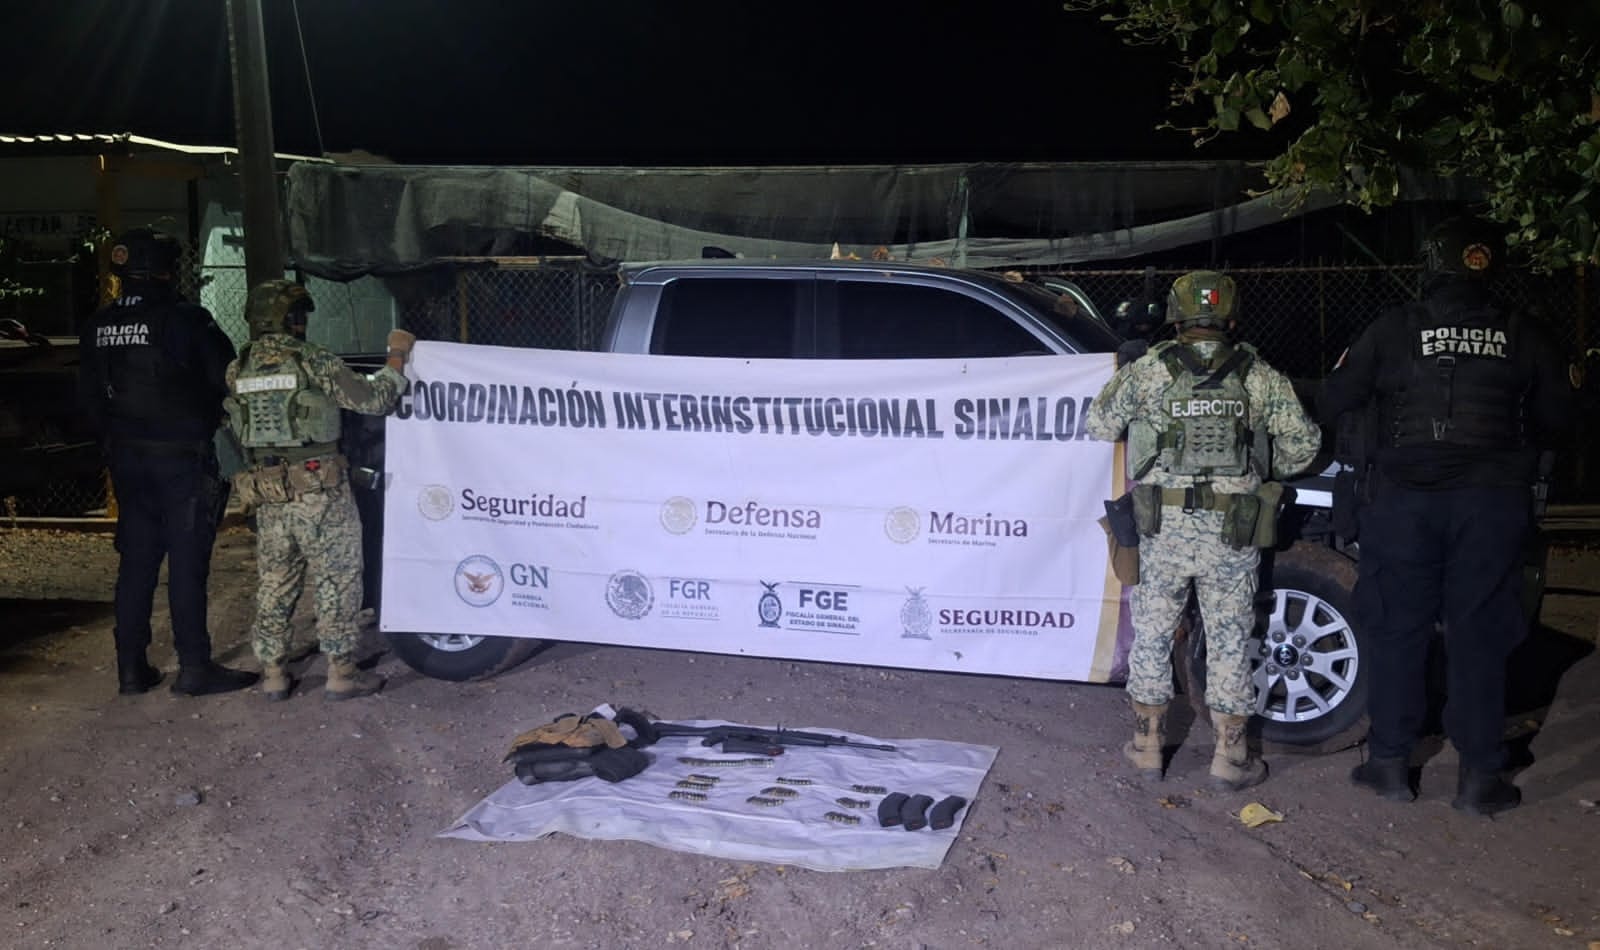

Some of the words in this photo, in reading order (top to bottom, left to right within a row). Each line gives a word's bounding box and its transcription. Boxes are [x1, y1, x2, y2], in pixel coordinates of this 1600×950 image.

[97, 322, 150, 337] POLICÍA
[1421, 327, 1507, 344] POLICÍA
[96, 335, 150, 347] ESTATAL
[1422, 340, 1507, 358] ESTATAL
[396, 380, 607, 429] COORDINACIÓN
[612, 391, 945, 440] INTERINSTITUCIONAL
[461, 488, 587, 519] Seguridad
[704, 500, 821, 529] Defensa
[928, 511, 1029, 538] Marina
[510, 563, 550, 589] GN
[670, 580, 711, 601] FGR
[799, 589, 849, 612] FGE
[938, 608, 1076, 630] SEGURIDAD
